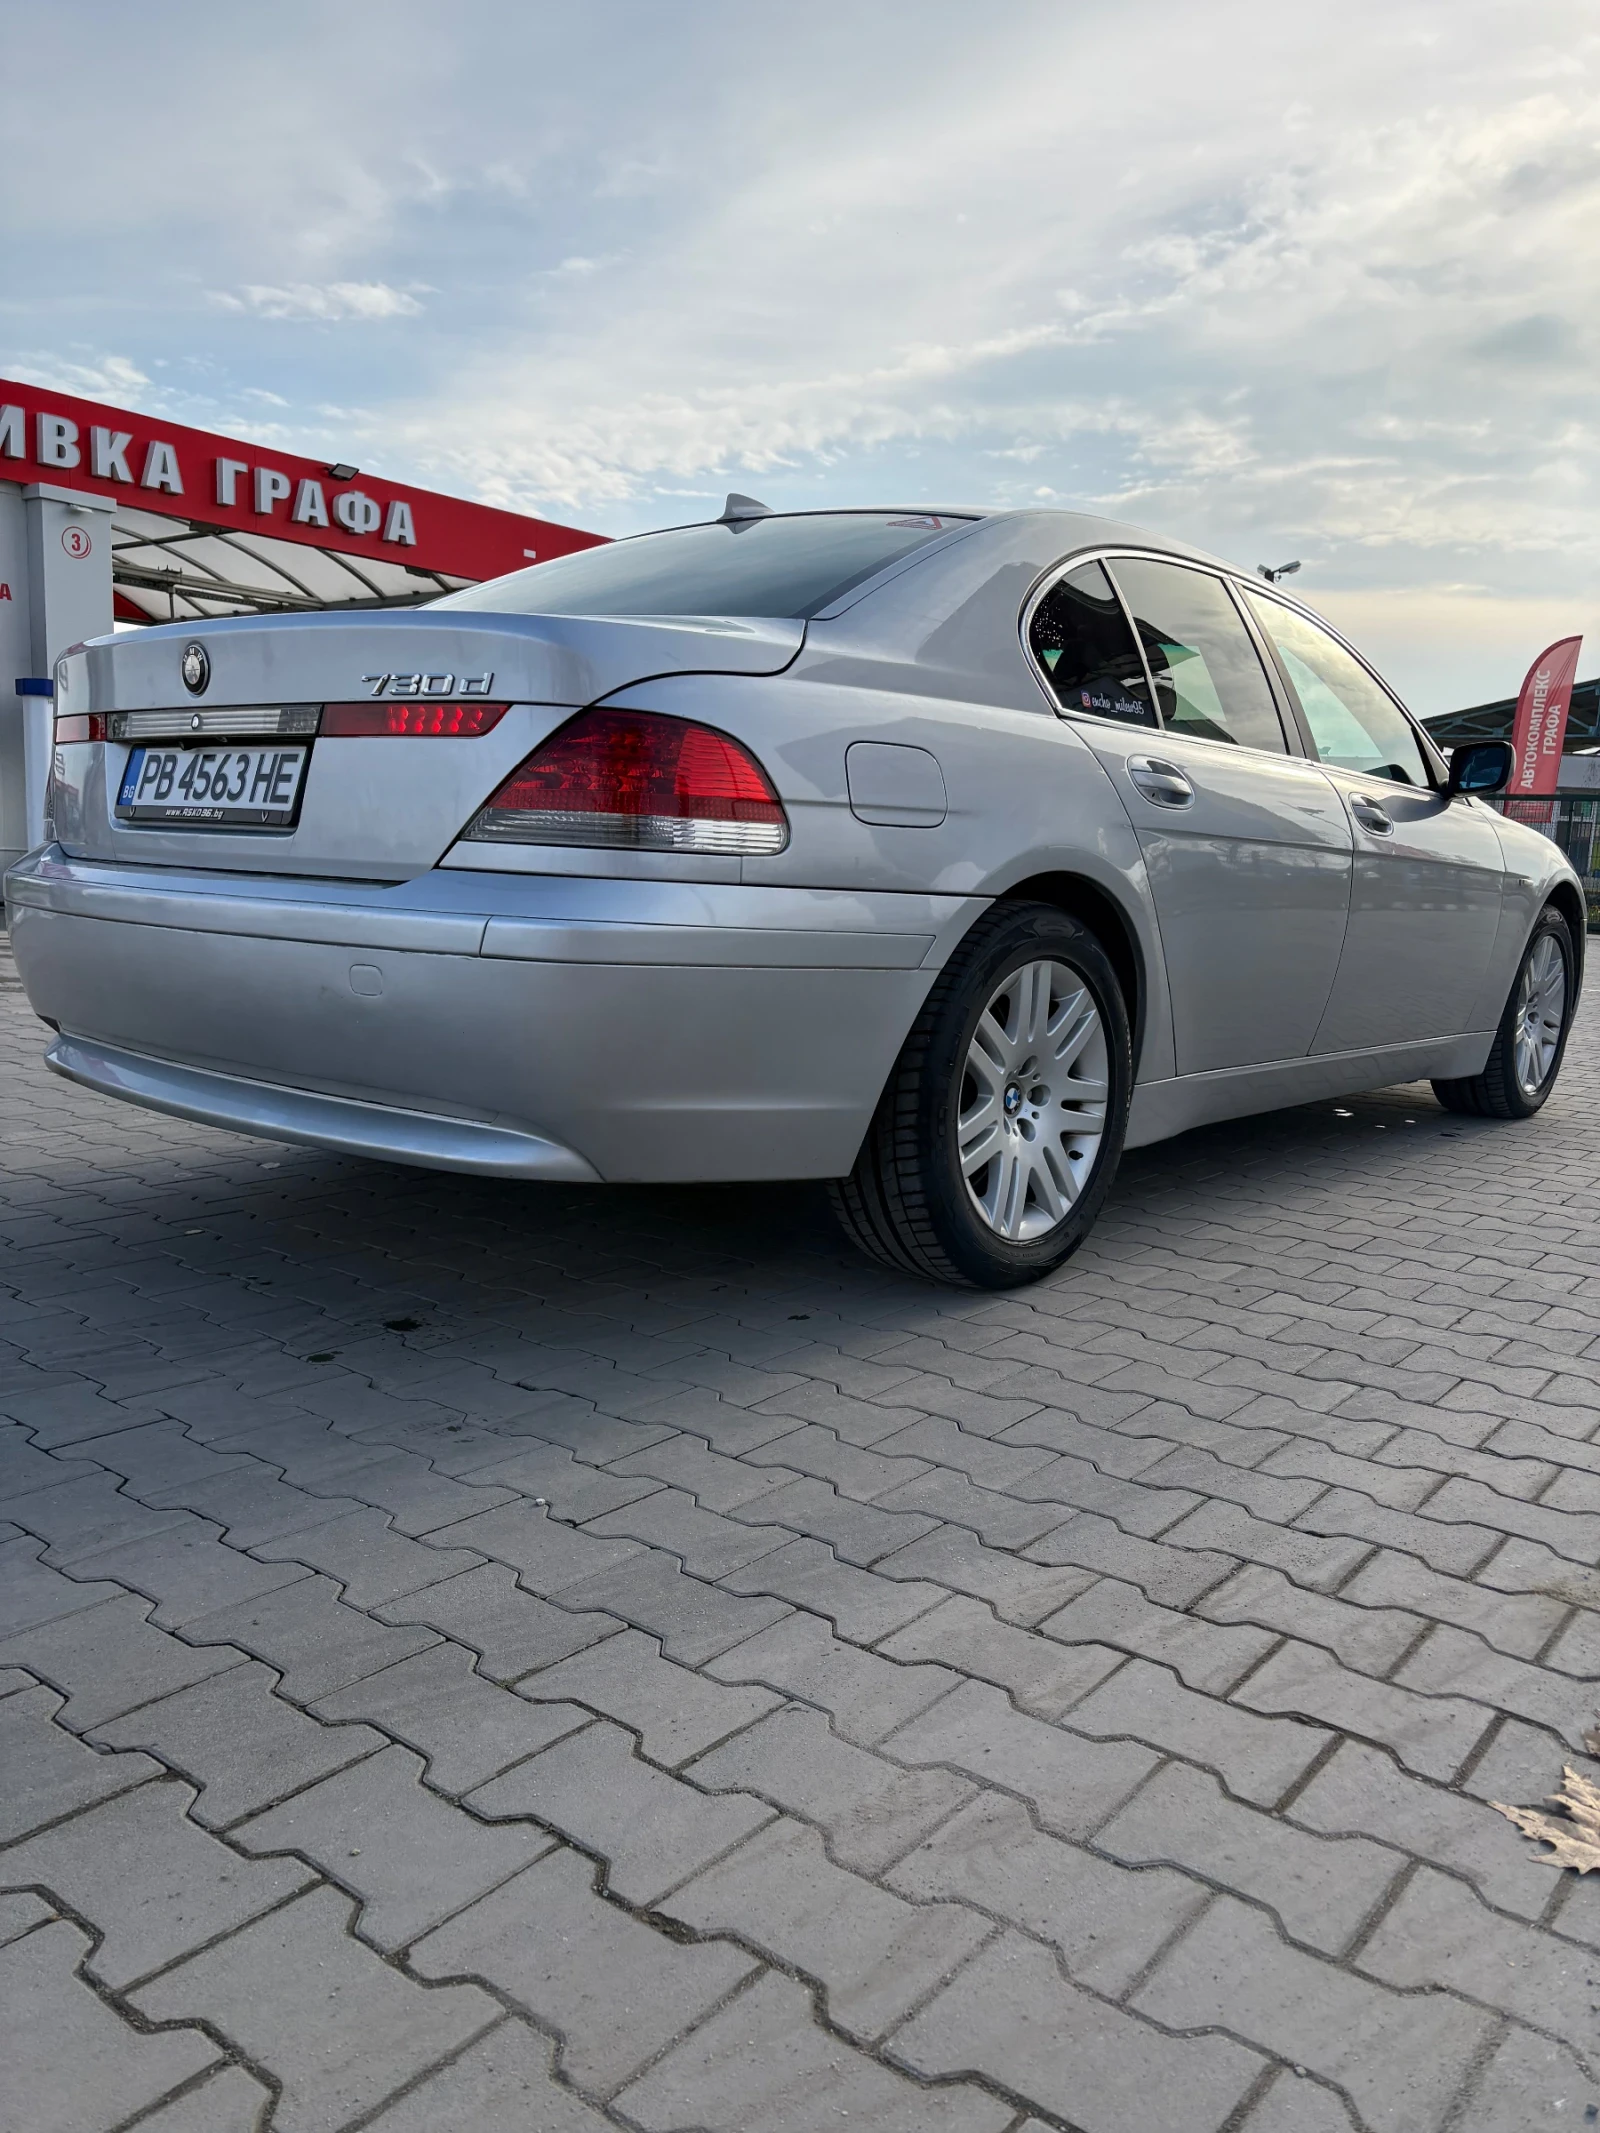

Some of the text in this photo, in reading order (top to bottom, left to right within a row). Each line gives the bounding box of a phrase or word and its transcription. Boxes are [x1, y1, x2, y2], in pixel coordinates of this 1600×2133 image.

[216, 457, 417, 546] ГРАФА
[71, 533, 81, 552] 3
[361, 672, 495, 696] 730d
[1520, 669, 1551, 789] АВТОКОМПЛЕКС
[1542, 704, 1562, 755] ГРАФА
[122, 785, 136, 799] BG
[177, 753, 251, 802] 4563
